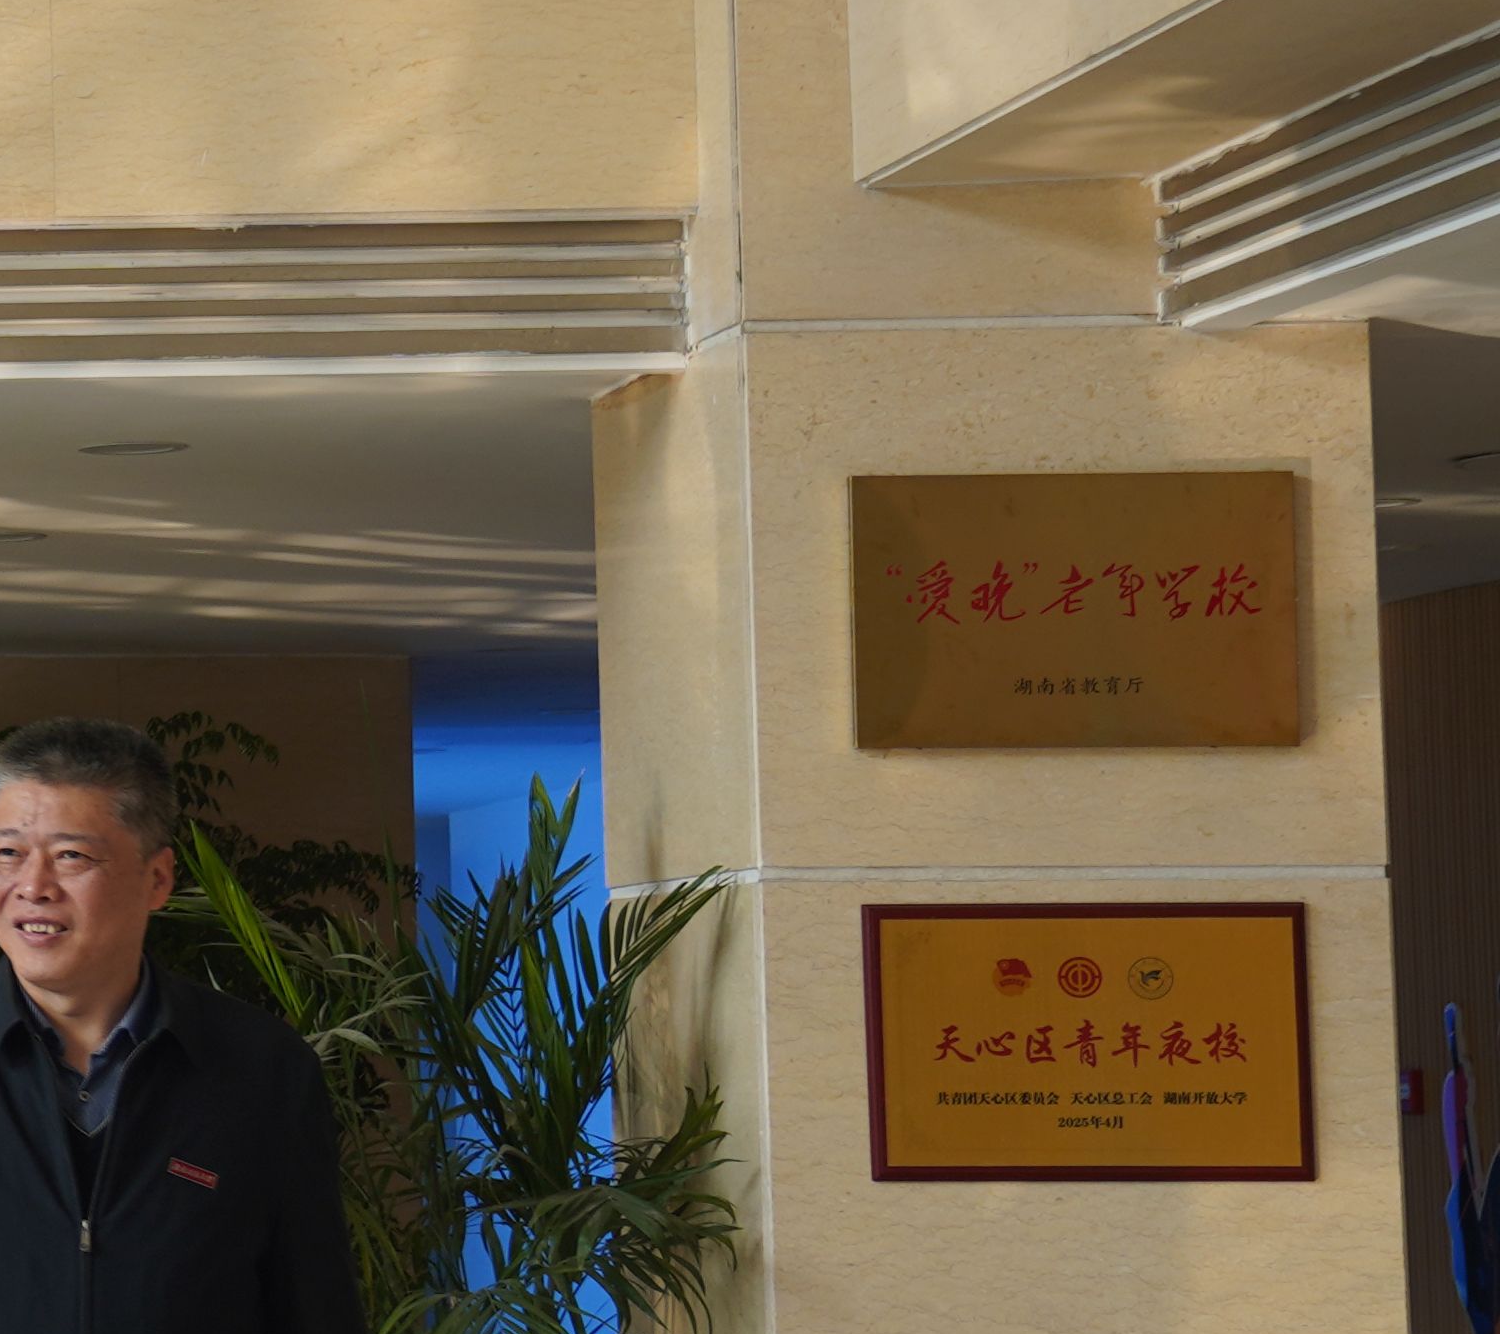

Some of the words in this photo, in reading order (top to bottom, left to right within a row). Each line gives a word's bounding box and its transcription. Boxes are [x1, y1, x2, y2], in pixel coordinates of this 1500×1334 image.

[1013, 676, 1145, 696] 湖南省教育厅
[933, 1019, 1248, 1068] 天心区青年夜校
[937, 1092, 1060, 1106] 共青团天心区委员会
[1070, 1092, 1153, 1105] 天心区总工会
[1163, 1091, 1248, 1105] 湖南开放大学
[1057, 1116, 1124, 1129] 2025年4月
